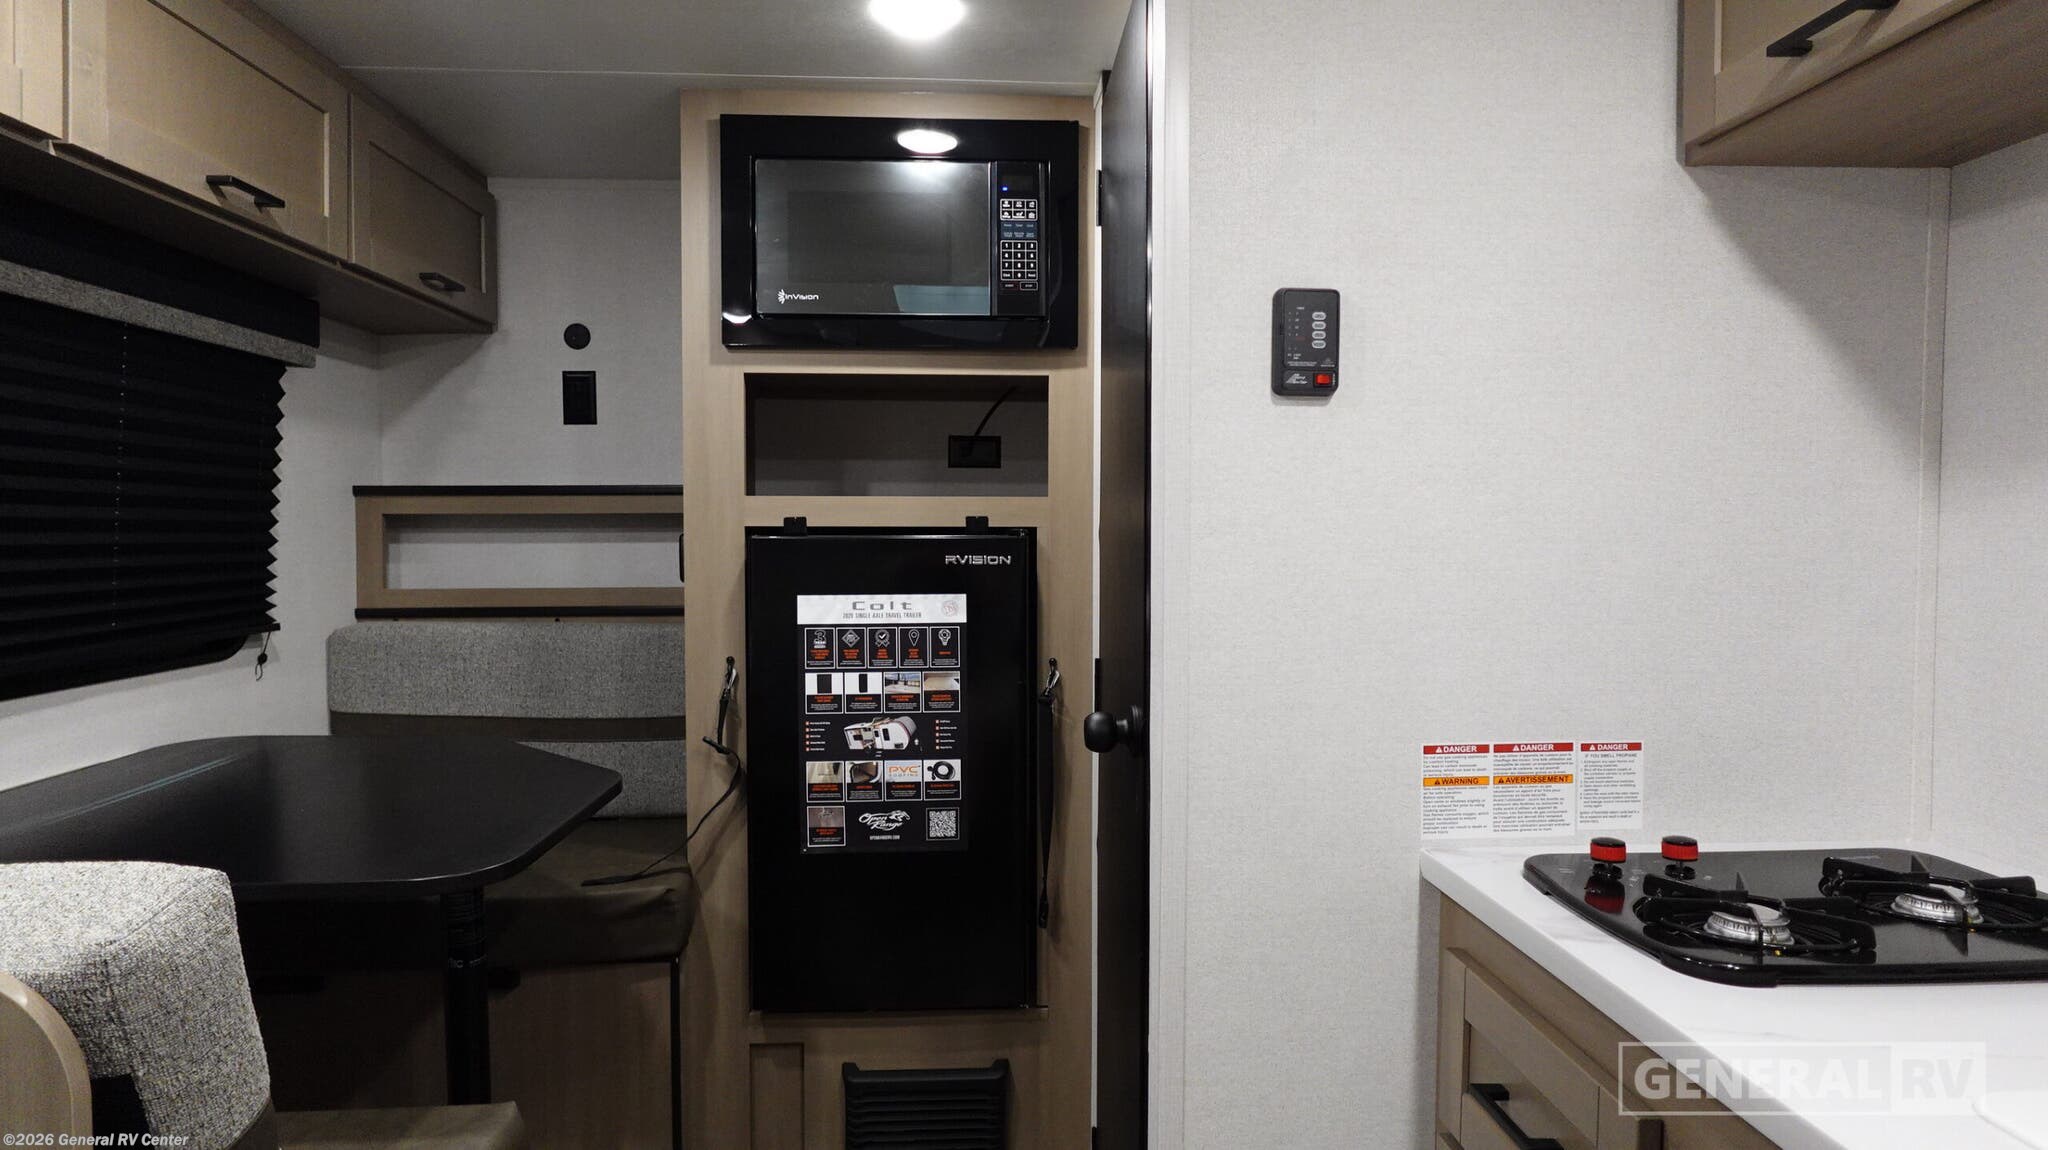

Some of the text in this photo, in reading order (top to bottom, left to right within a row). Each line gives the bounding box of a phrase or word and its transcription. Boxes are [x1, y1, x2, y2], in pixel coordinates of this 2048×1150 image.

[945, 554, 1011, 565] RVISION
[852, 600, 912, 611] Colt
[1442, 777, 1479, 785] WARNING
[1506, 775, 1569, 784] AVERTISSEMENT
